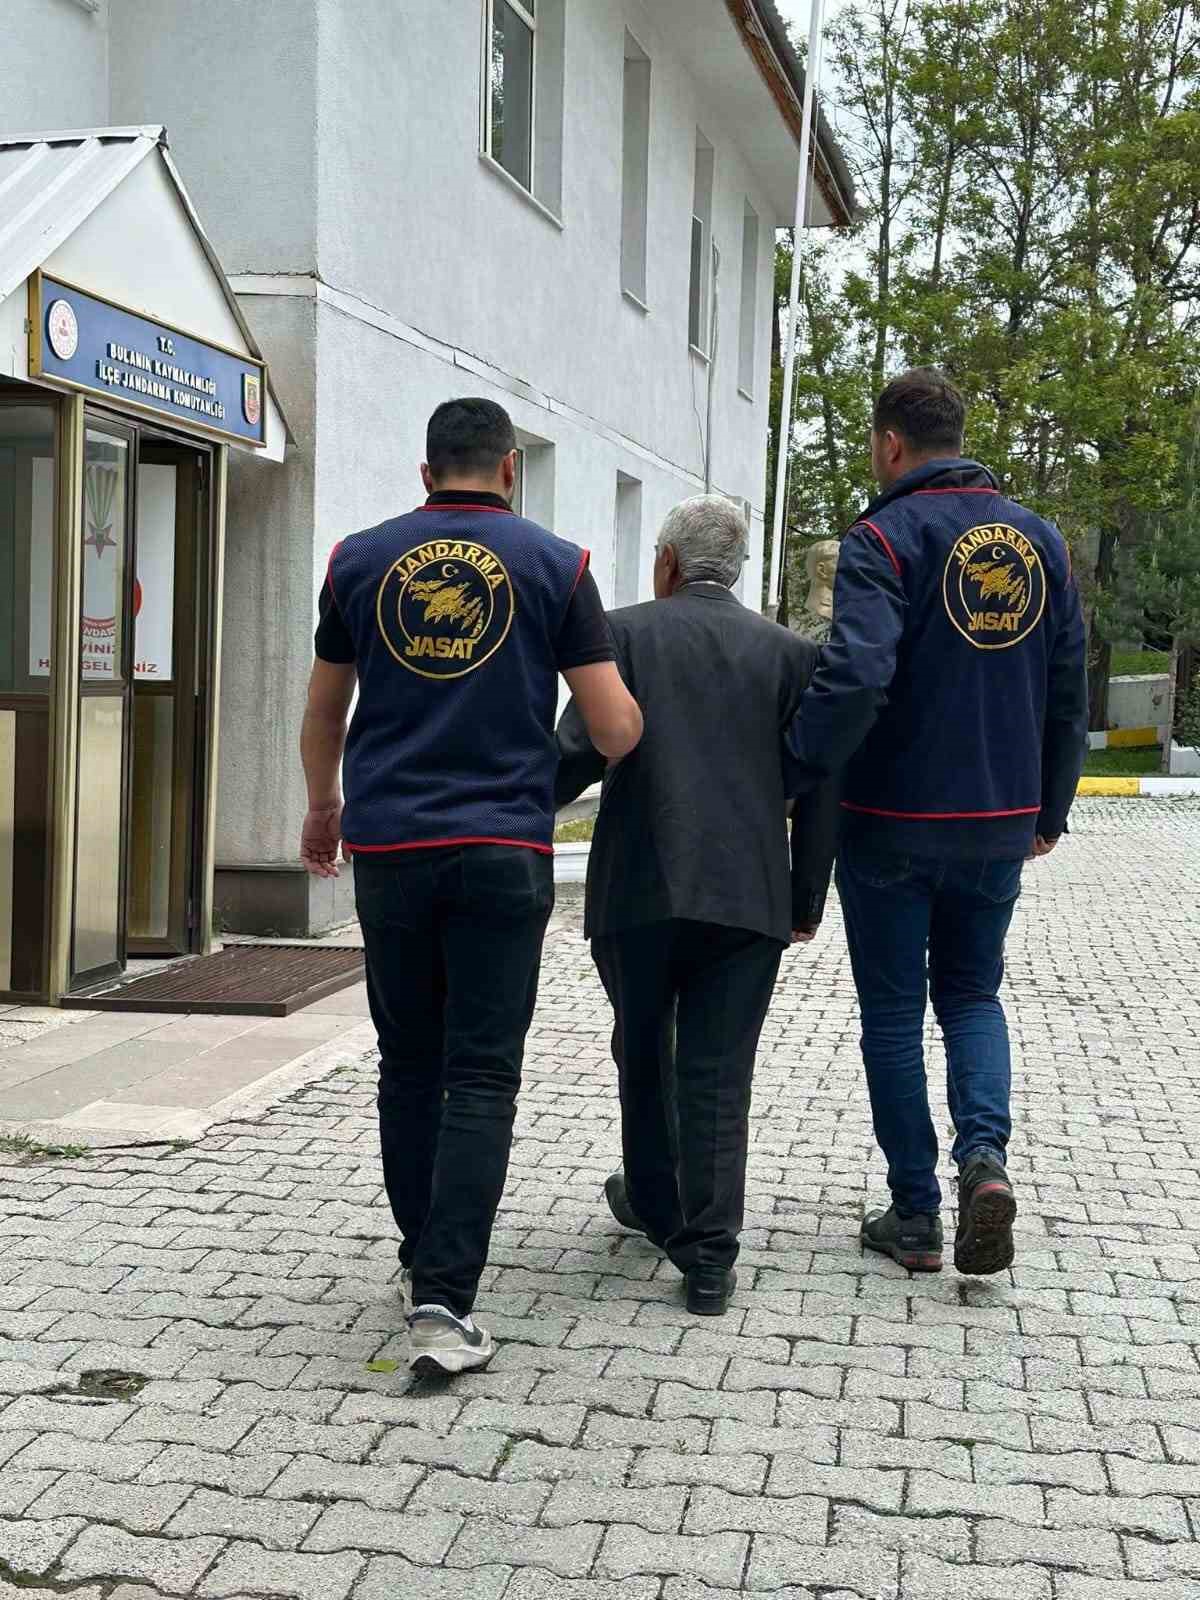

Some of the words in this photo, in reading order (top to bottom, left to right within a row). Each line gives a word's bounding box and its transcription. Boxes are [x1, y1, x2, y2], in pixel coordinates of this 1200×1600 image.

[99, 359, 120, 385] İLÇE
[122, 372, 171, 401] JANDARMA
[395, 543, 505, 590] JANDARMA
[956, 527, 1036, 569] JANDARMA
[968, 611, 1023, 631] JASAT
[404, 636, 479, 660] JASAT
